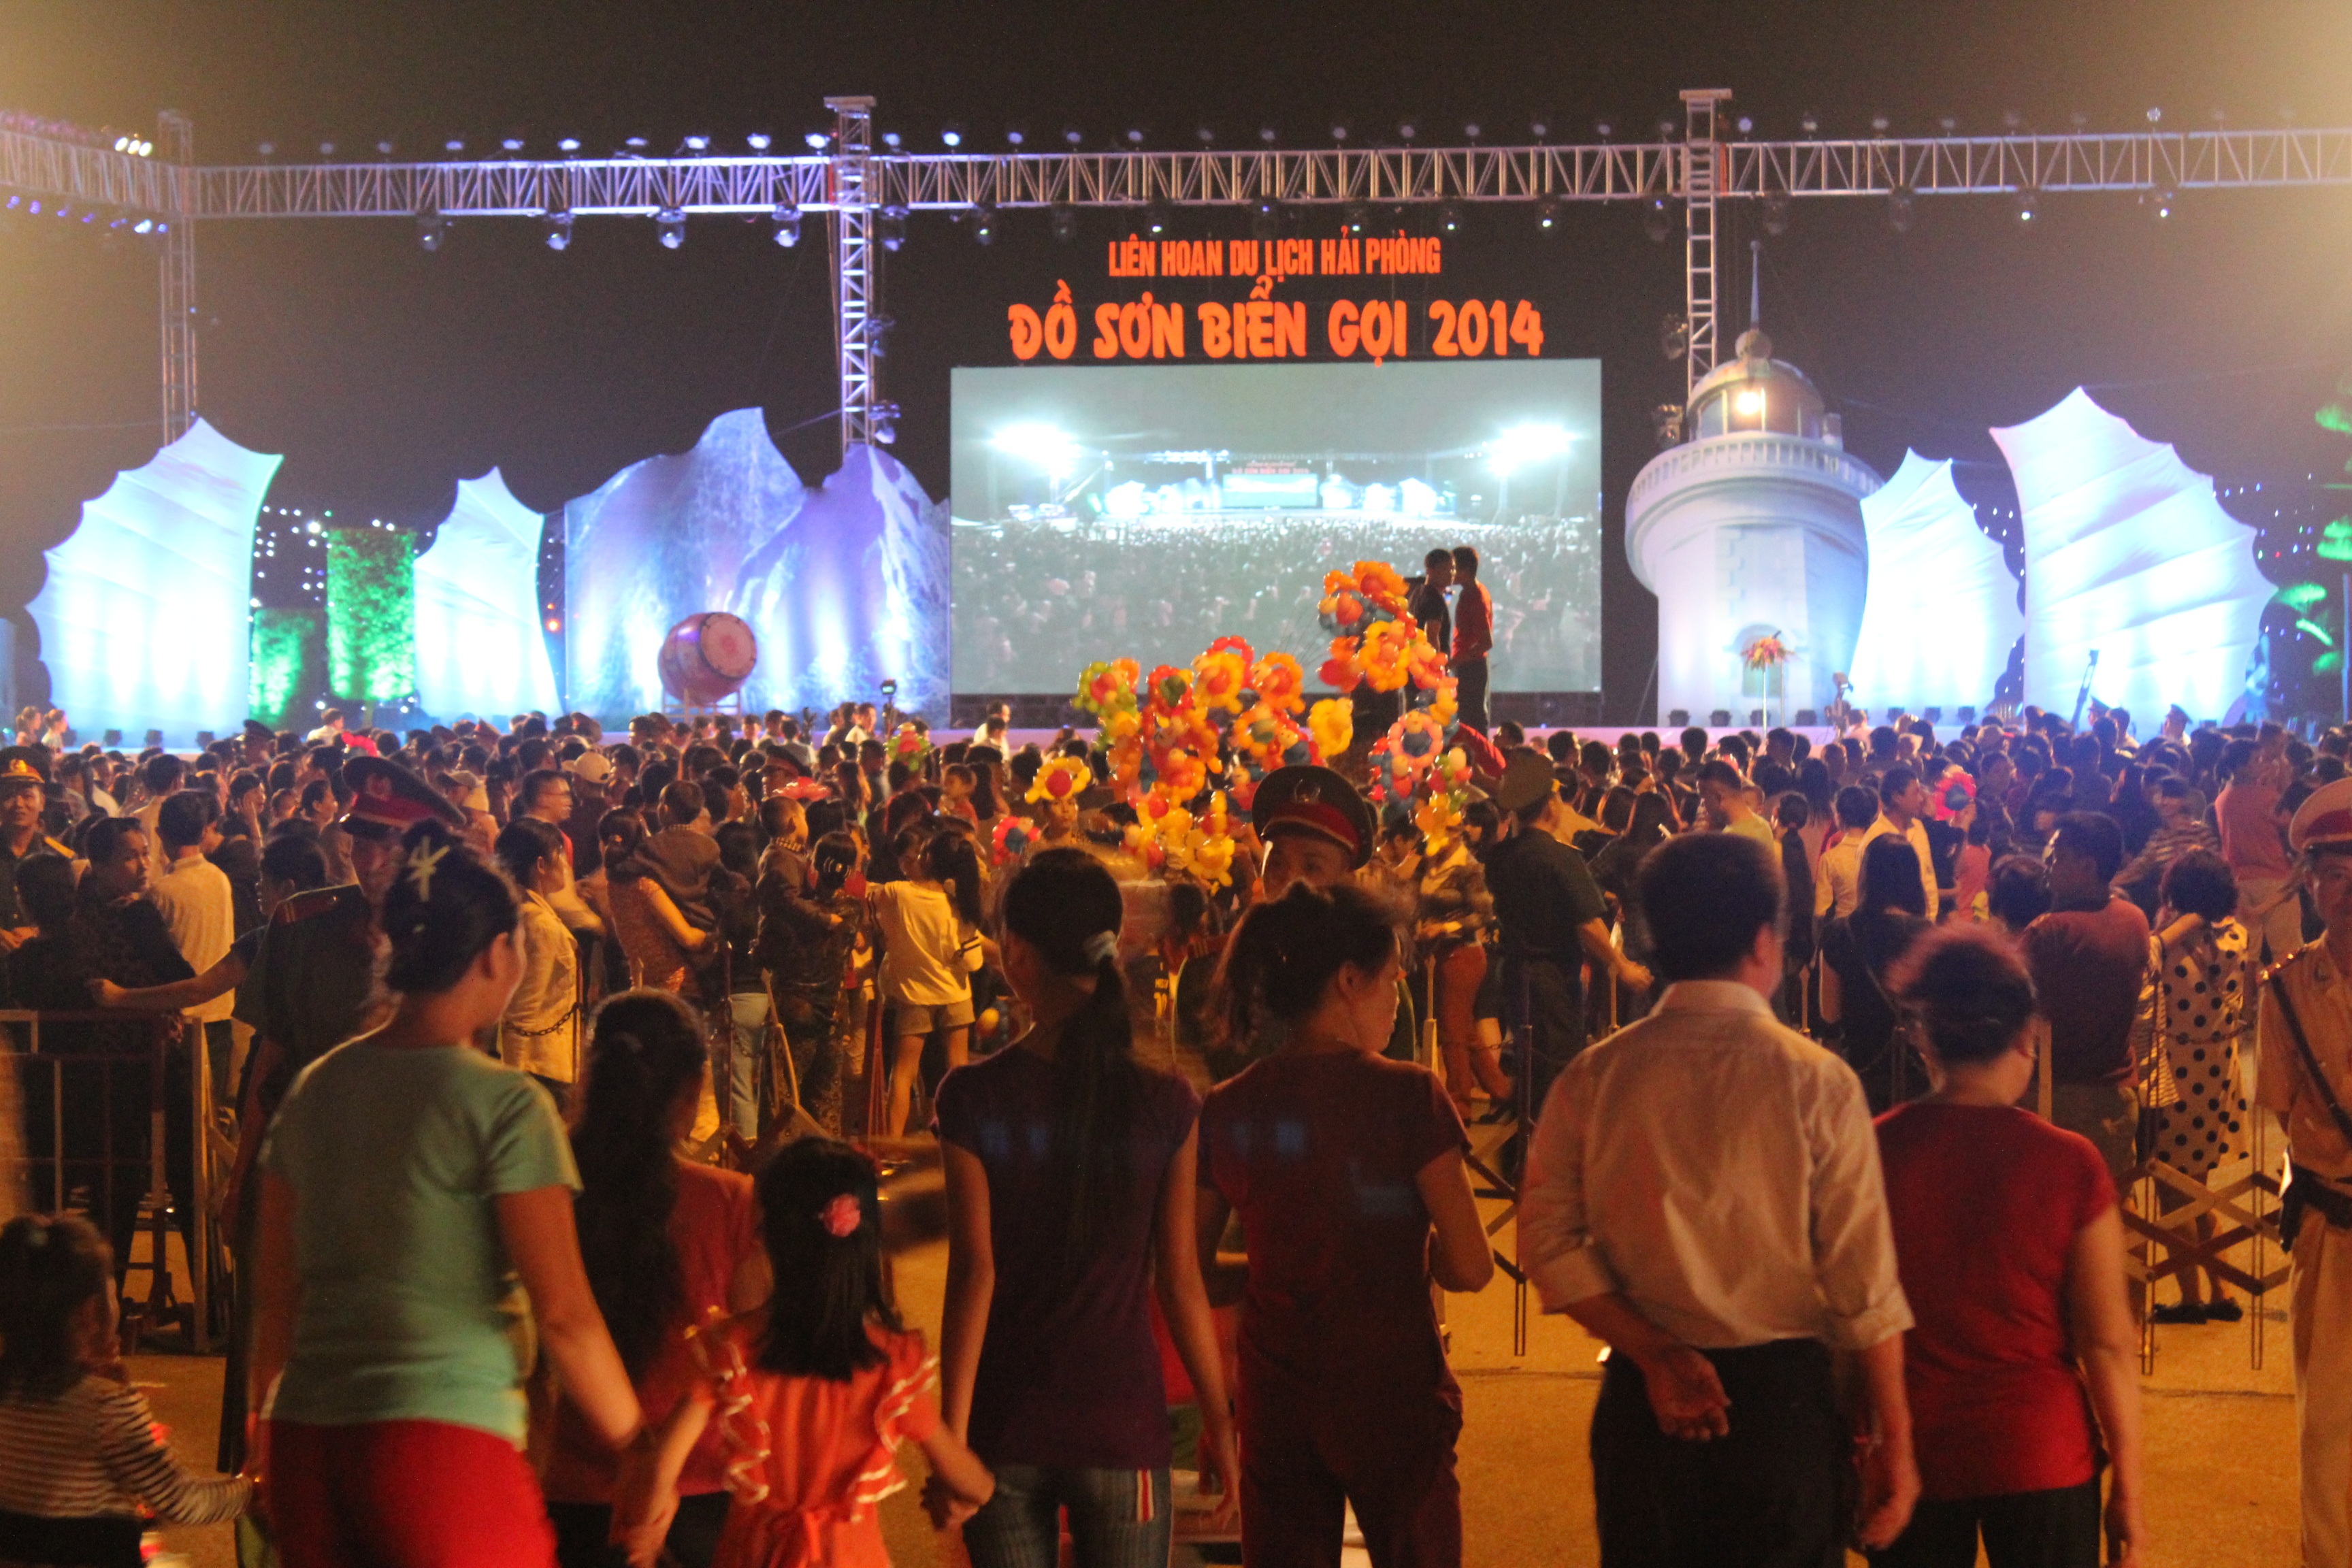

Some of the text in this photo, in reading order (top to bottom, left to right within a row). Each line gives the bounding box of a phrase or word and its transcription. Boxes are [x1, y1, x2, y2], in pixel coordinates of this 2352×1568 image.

[1109, 225, 1441, 282] LIÊN HOAN DU LỊCH HẢI PHÒNG
[1008, 274, 1544, 368] ĐỒ SƠN BIỂN GỌI 2014
